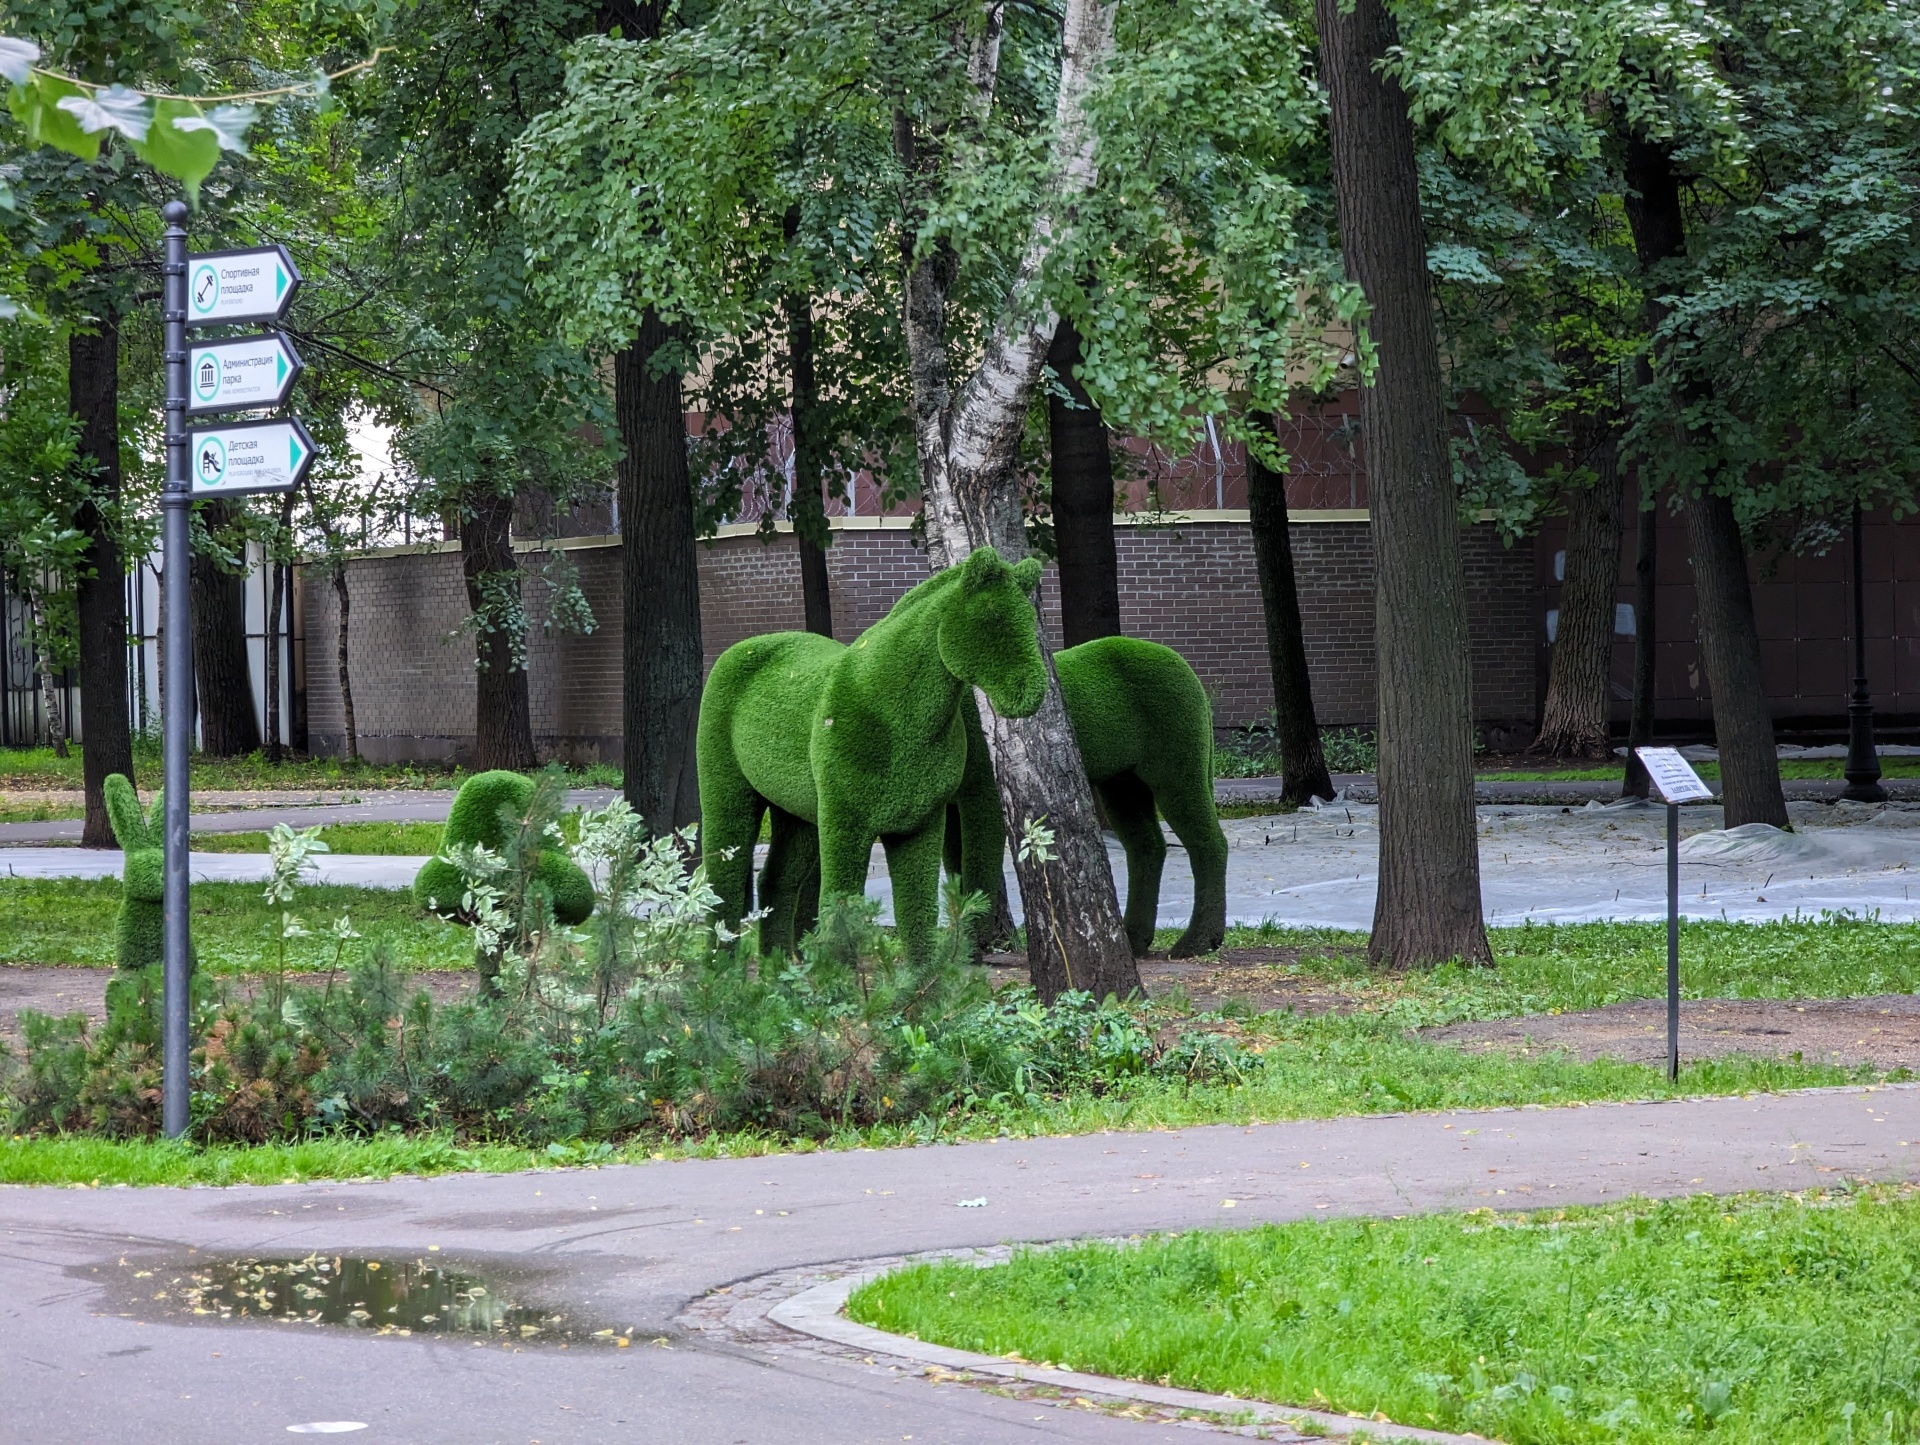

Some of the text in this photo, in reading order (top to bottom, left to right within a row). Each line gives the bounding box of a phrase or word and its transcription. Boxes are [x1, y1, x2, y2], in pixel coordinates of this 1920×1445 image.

[221, 268, 260, 280] Спортивная
[220, 284, 254, 294] площадка
[223, 356, 273, 370] Администрация
[222, 374, 242, 386] парка
[228, 440, 258, 452] Детская
[228, 456, 264, 466] площадка
